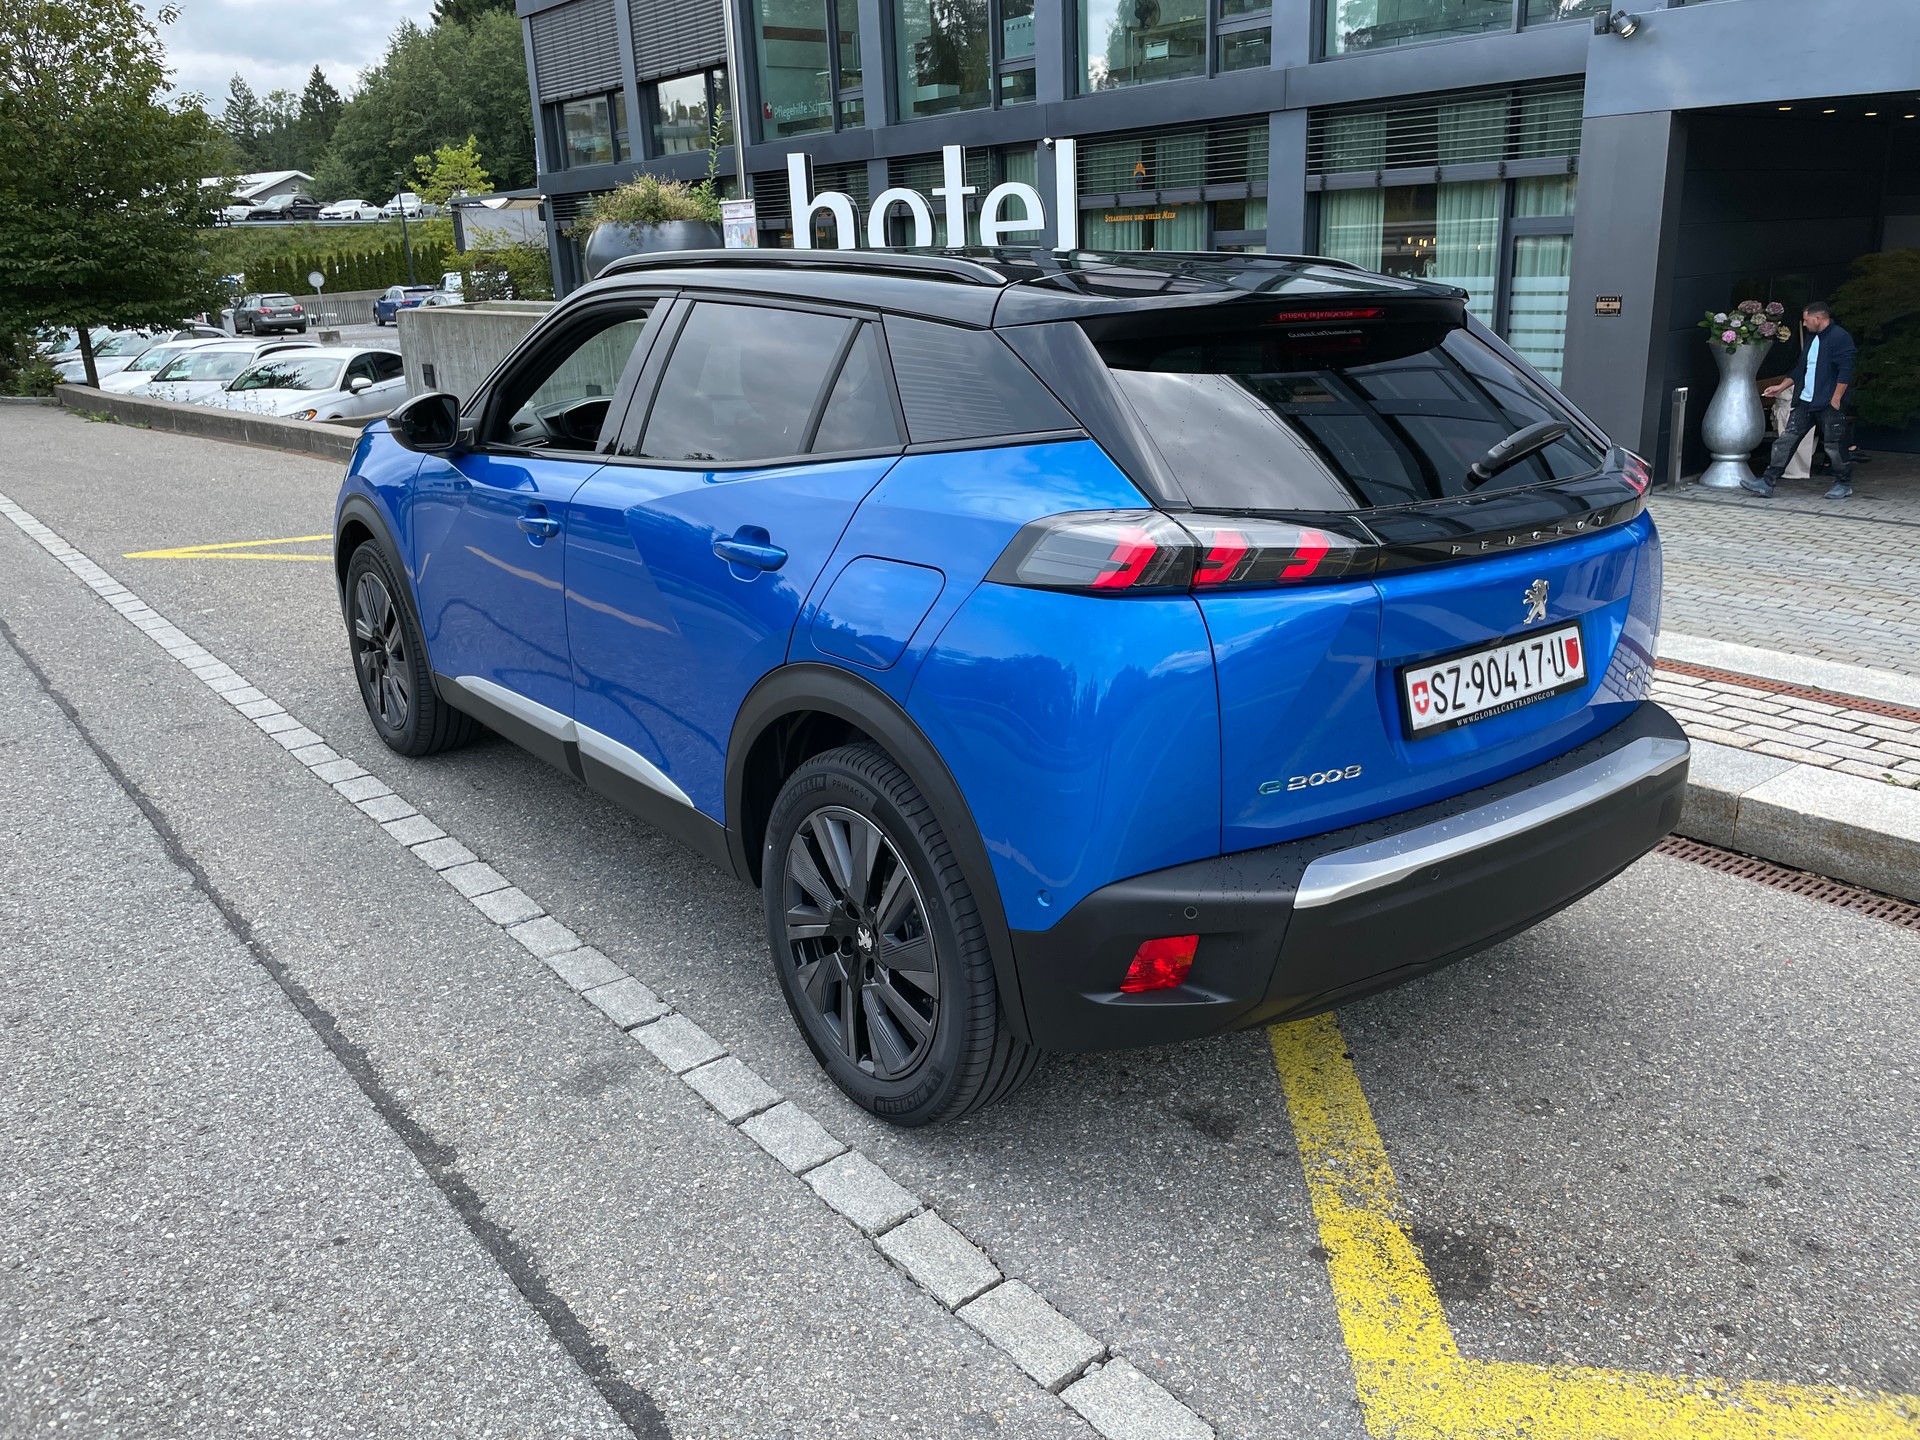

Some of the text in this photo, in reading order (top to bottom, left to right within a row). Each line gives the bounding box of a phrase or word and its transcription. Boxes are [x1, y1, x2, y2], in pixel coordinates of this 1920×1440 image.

[787, 139, 1077, 249] hotel
[1451, 515, 1604, 555] PEUGEOT
[832, 779, 864, 800] PRIMACY
[1286, 764, 1362, 791] 2008
